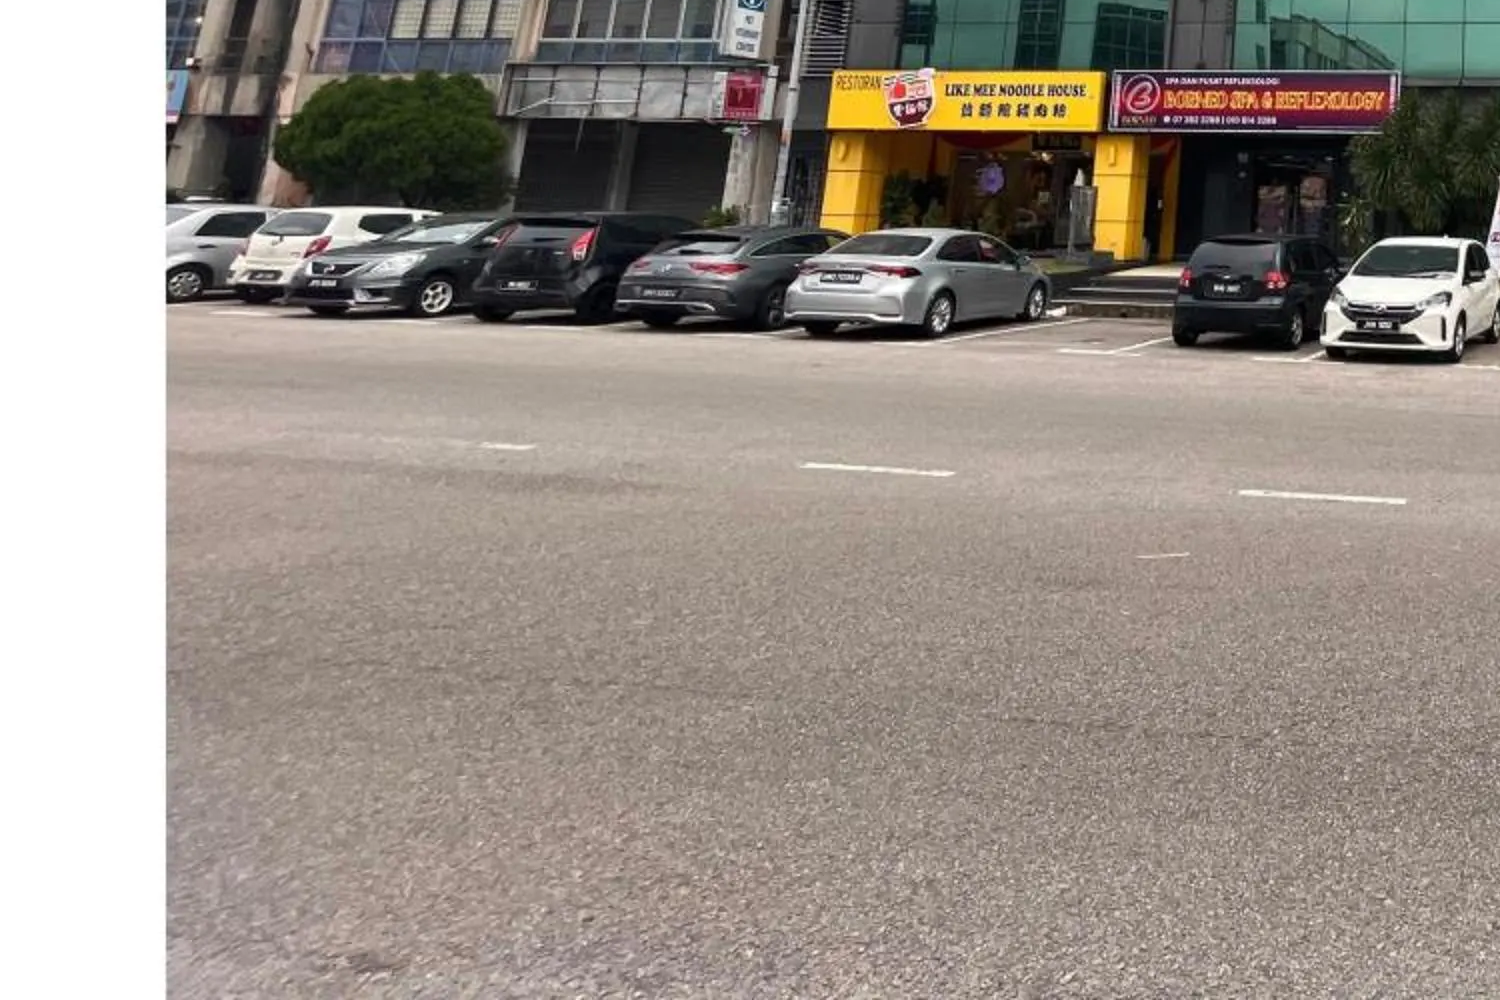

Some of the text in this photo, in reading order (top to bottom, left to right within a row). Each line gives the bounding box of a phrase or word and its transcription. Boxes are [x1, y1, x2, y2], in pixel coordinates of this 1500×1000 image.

[835, 75, 881, 90] RESTORAN
[945, 83, 1087, 97] LIKE MEE NOODLE HOUSE
[1230, 91, 1259, 109] SPA
[1261, 92, 1273, 108] &
[1275, 91, 1385, 110] REFLEXOLOGY
